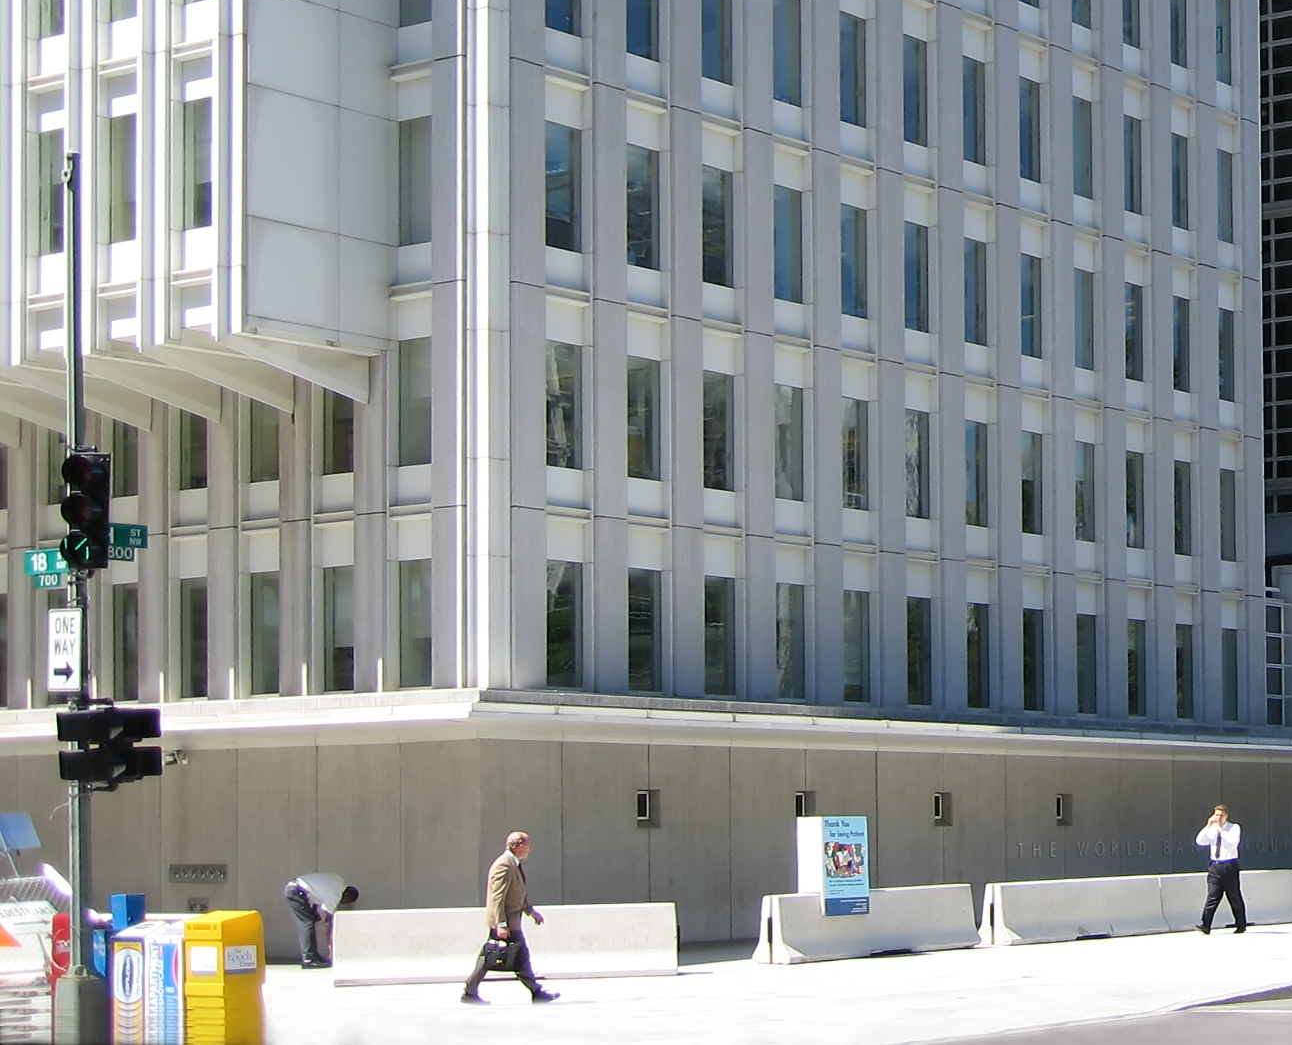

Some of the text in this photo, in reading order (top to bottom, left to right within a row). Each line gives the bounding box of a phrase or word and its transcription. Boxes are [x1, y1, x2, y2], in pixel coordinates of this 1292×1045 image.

[130, 528, 141, 537] ST
[129, 537, 142, 545] NW
[108, 545, 132, 559] 800
[31, 552, 47, 571] 18
[40, 574, 58, 586] 700
[55, 616, 75, 634] ONE
[54, 638, 76, 655] WAY
[825, 819, 850, 827] Thank You
[1017, 839, 1290, 858] THE WORLD BAN ROUP
[227, 951, 252, 963] Epoch
[149, 944, 159, 1004] APARTMENT
